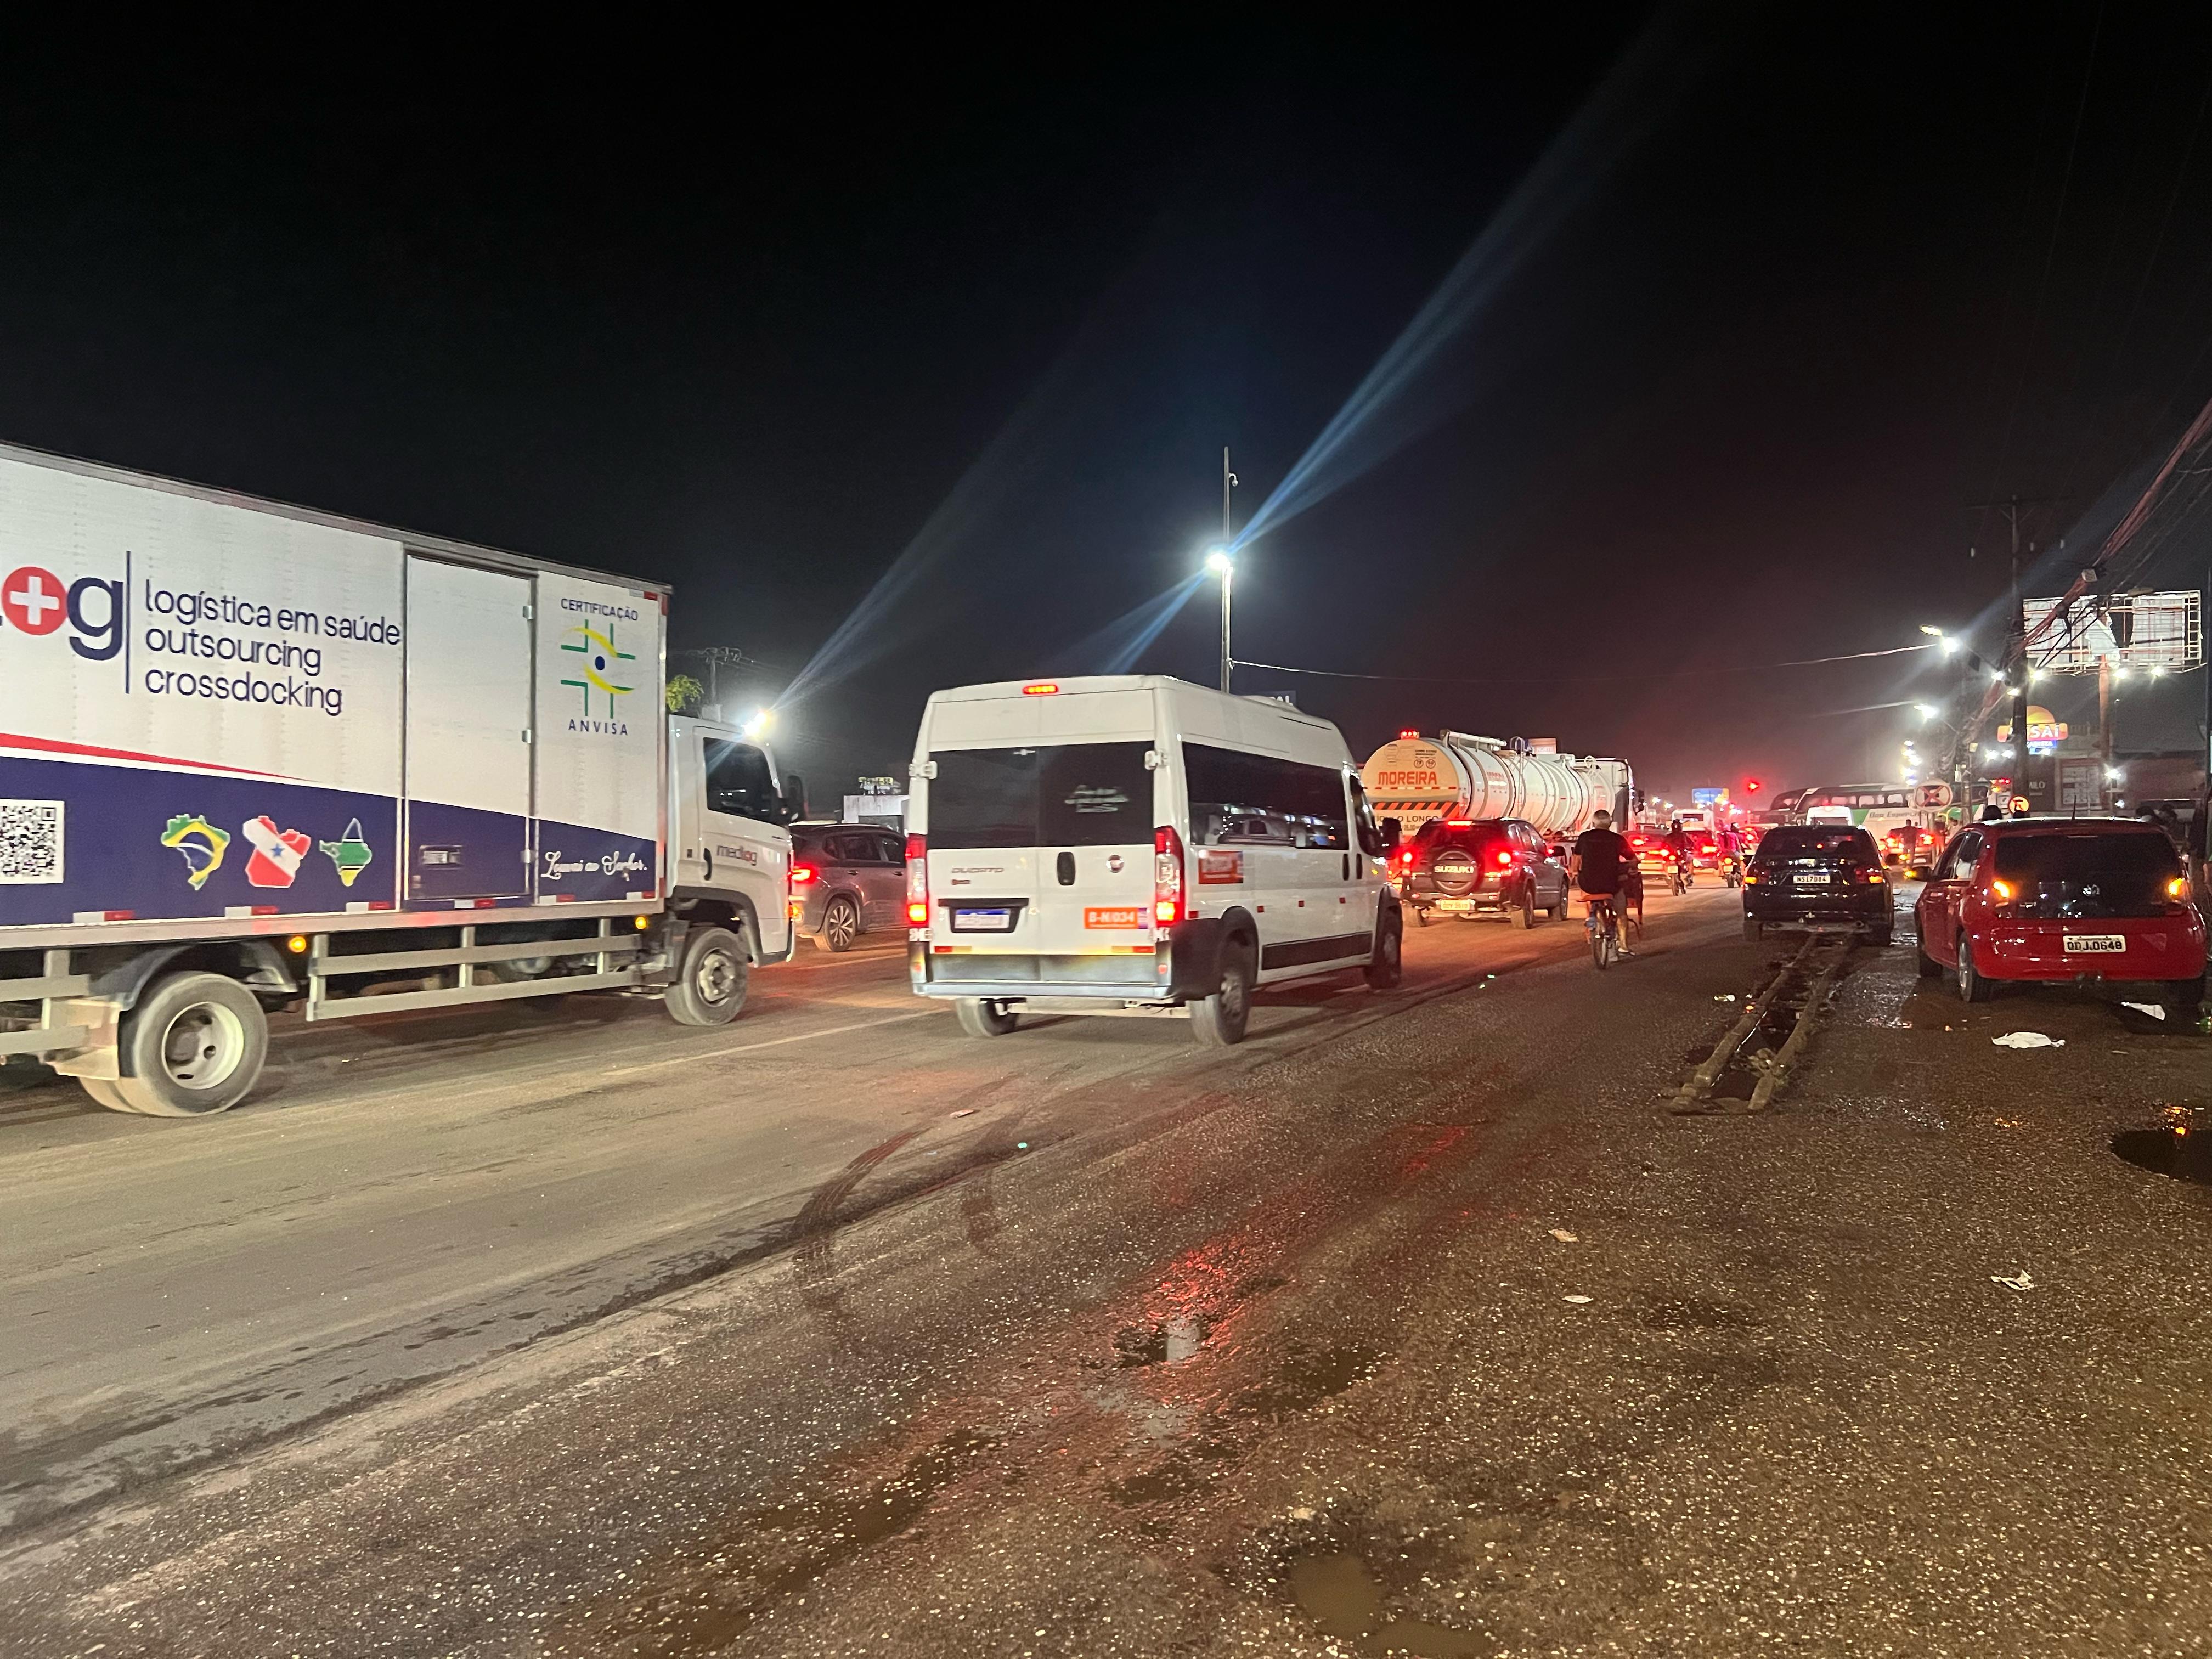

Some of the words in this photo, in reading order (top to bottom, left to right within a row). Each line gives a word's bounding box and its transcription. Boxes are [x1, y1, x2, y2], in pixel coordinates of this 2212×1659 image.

[146, 579, 271, 628] logística
[278, 608, 318, 635] em
[325, 614, 400, 645] saúde
[561, 598, 639, 621] CERTIFICAÇÃO
[146, 627, 321, 675] outsourcing
[146, 669, 342, 716] crossdocking
[568, 719, 628, 736] ANVISA
[1378, 771, 1437, 785] MOREIRA
